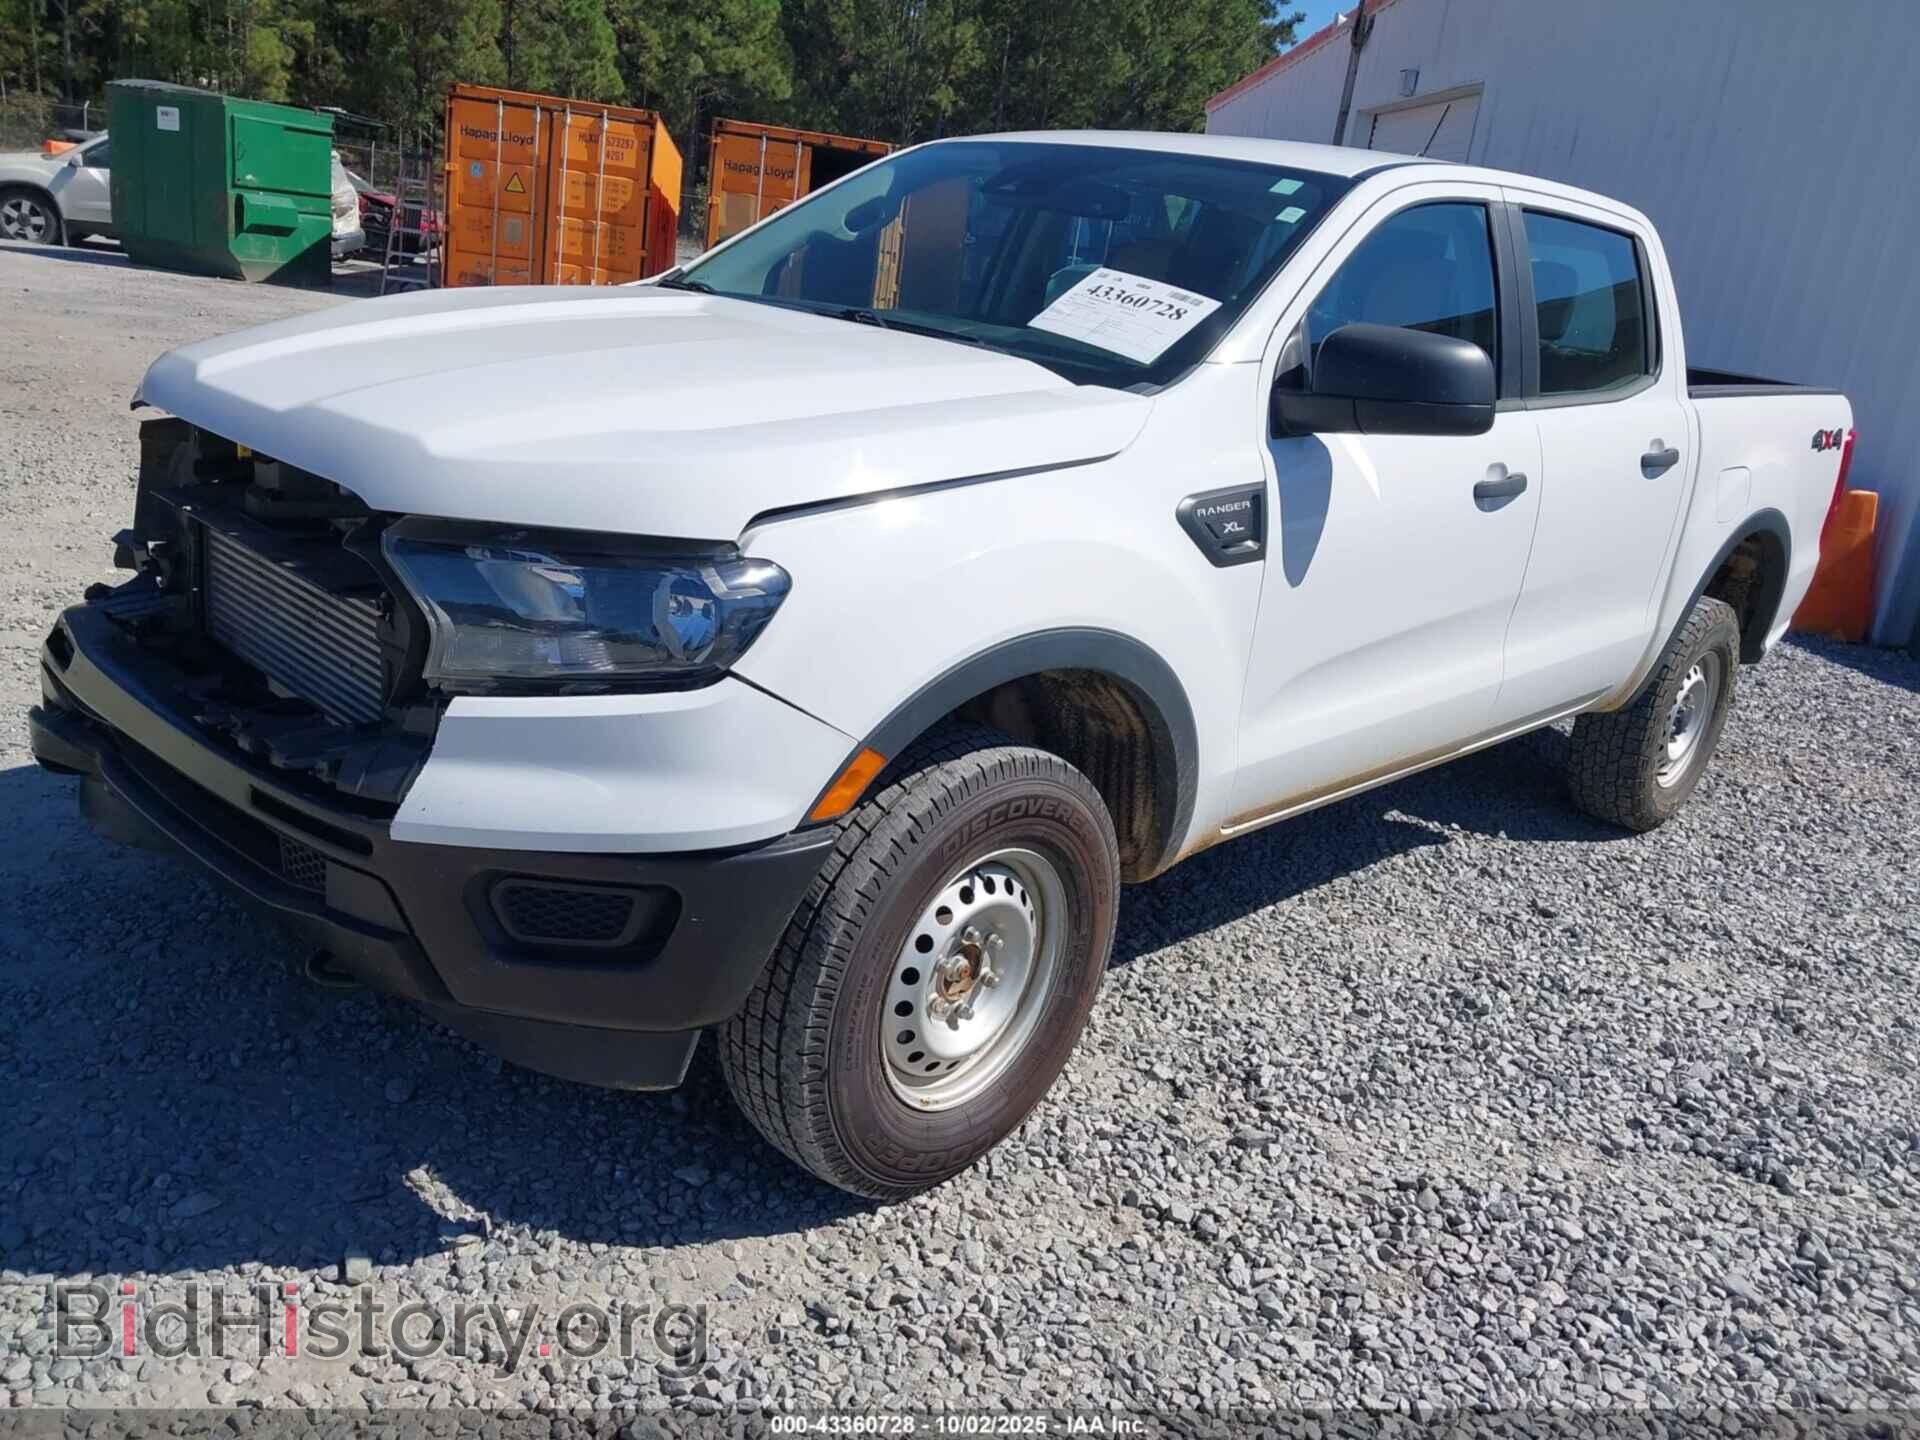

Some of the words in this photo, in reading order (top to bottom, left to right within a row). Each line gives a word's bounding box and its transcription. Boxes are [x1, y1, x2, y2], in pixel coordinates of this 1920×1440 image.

[1086, 283, 1189, 321] 43360728
[1196, 500, 1251, 518] RANGER
[1222, 521, 1246, 534] XL
